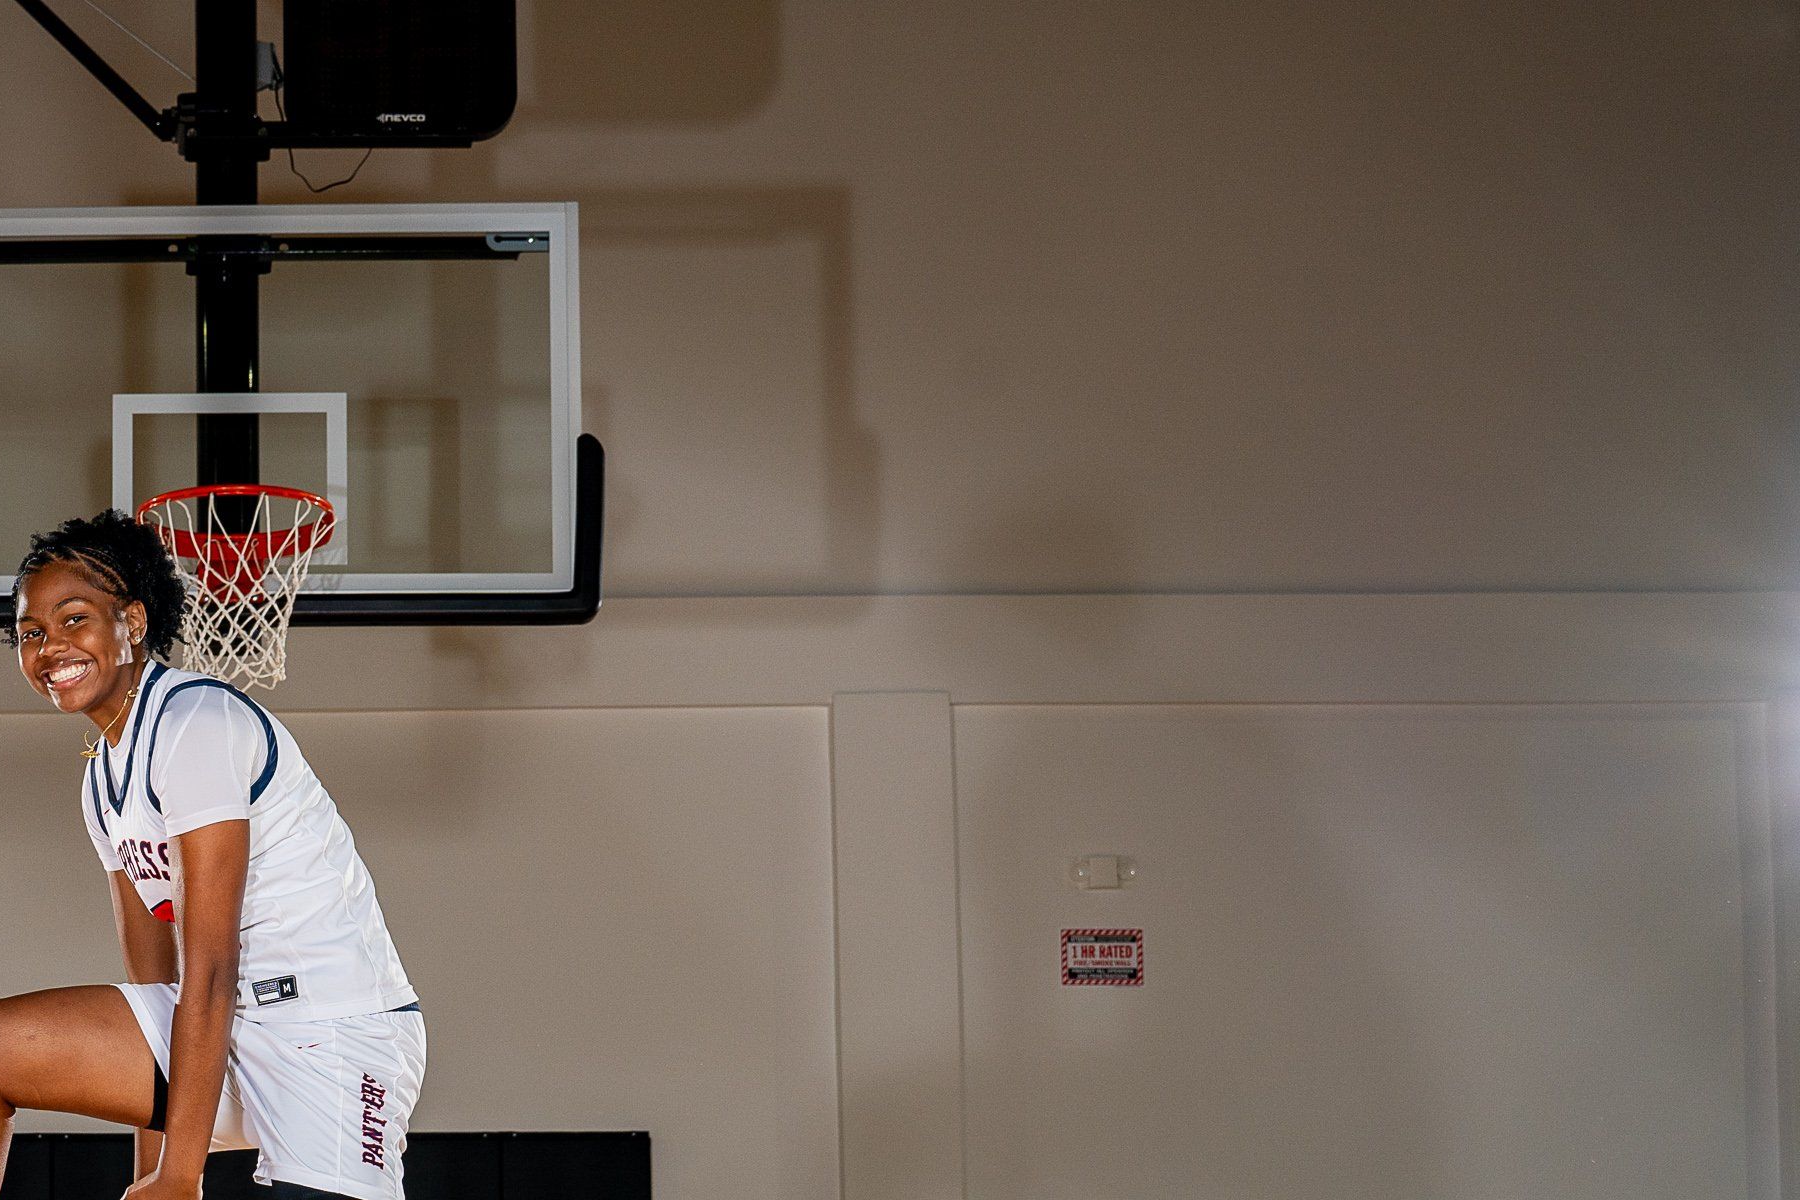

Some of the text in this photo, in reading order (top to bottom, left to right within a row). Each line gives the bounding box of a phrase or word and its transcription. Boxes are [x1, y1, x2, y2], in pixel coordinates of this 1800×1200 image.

[1081, 945, 1095, 958] HR
[1099, 945, 1133, 958] RATED
[283, 982, 292, 993] M
[360, 1072, 387, 1170] PANTERS
